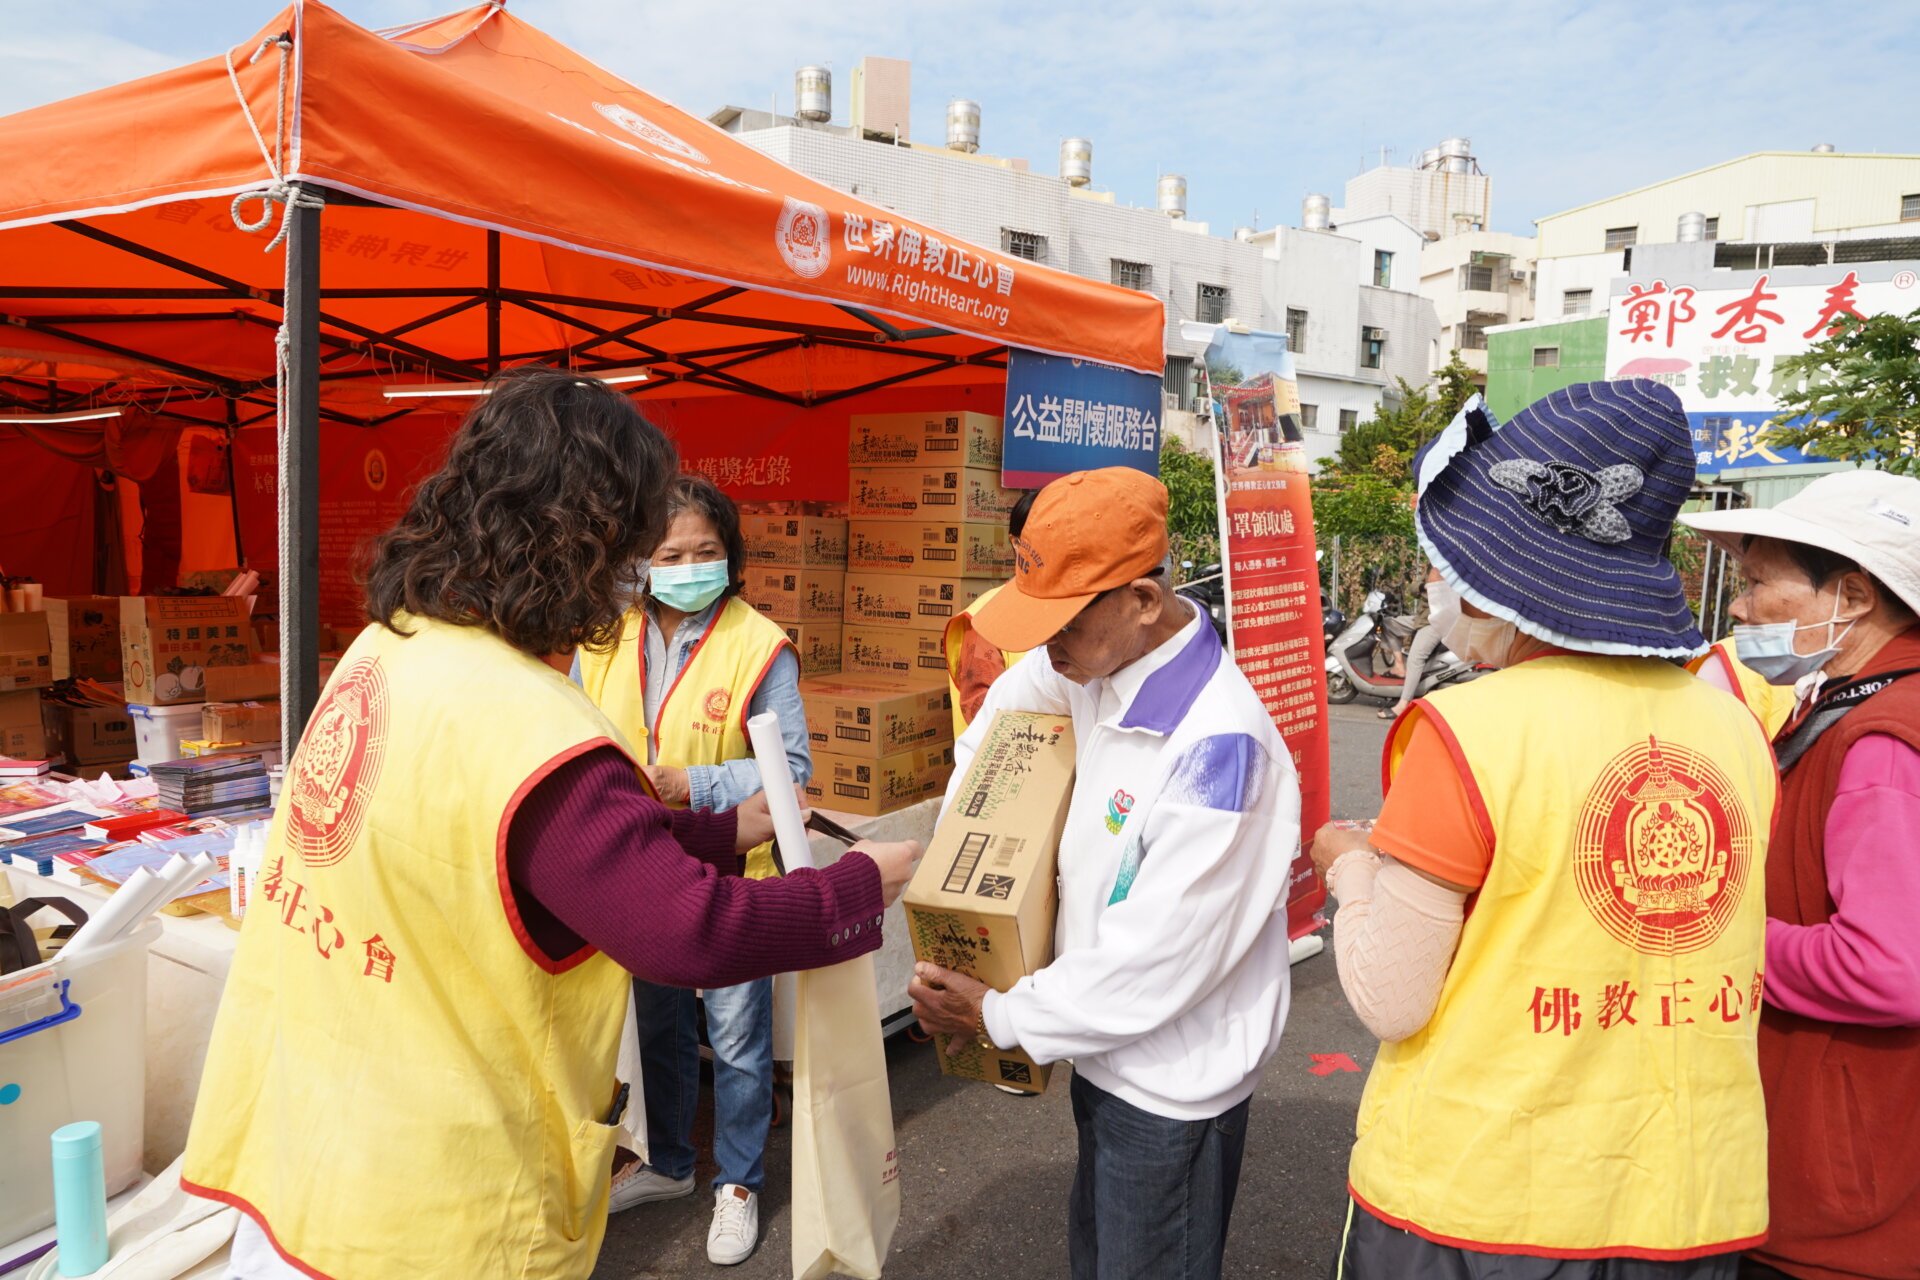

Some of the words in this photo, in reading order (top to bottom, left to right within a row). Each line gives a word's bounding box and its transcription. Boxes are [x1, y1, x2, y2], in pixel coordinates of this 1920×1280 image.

[843, 211, 1014, 296] 世界佛教正心會
[847, 265, 1009, 326] www.RightHeart.org
[1012, 393, 1157, 452] 公益關懷服務台
[1227, 509, 1295, 539] 罩領取處
[992, 885, 1009, 900] 10
